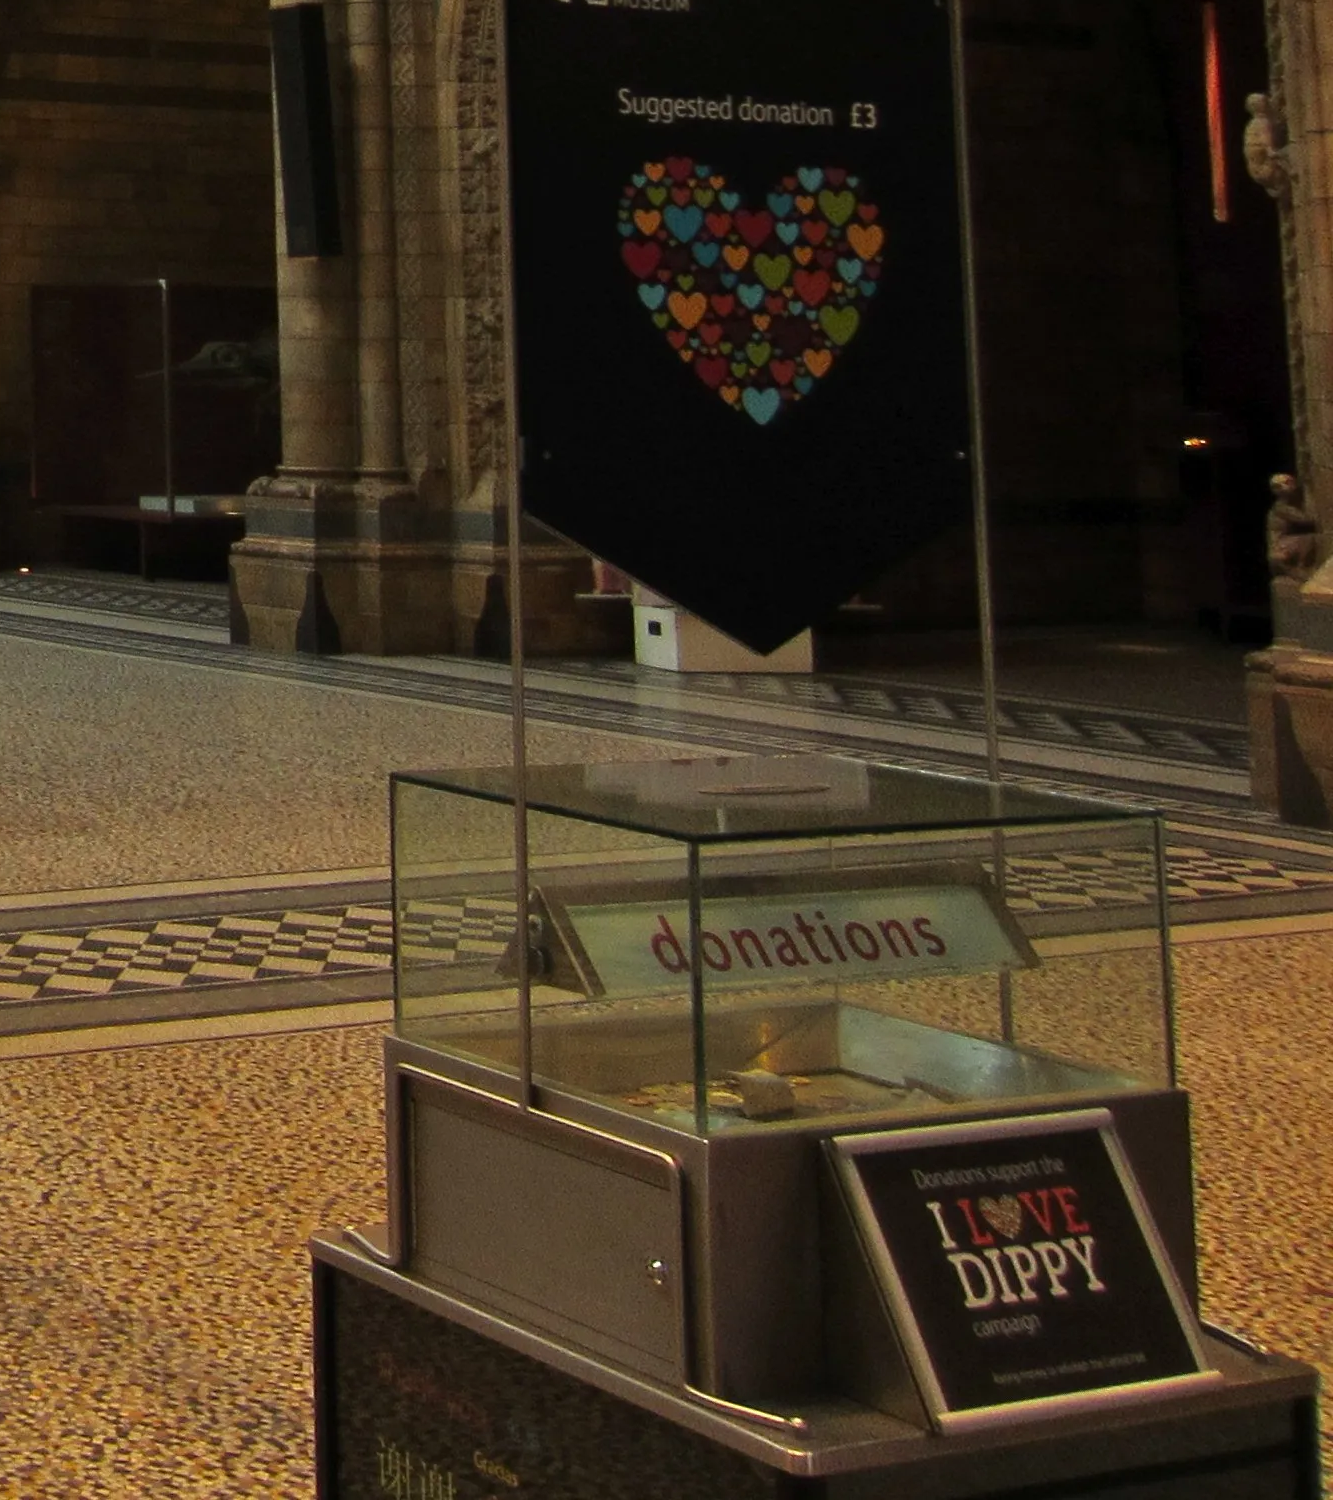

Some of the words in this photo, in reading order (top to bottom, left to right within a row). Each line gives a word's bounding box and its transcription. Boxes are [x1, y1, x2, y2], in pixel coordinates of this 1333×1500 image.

[618, 88, 733, 124] Suggested
[738, 96, 834, 126] donation
[849, 102, 878, 128] £3
[651, 910, 947, 974] donations
[911, 1167, 986, 1190] Donations
[987, 1160, 1040, 1183] support
[1039, 1154, 1065, 1175] the
[926, 1202, 957, 1249] I
[947, 1235, 1106, 1308] DIPPY
[972, 1314, 1042, 1338] campaign
[472, 1448, 520, 1489] Gracias
